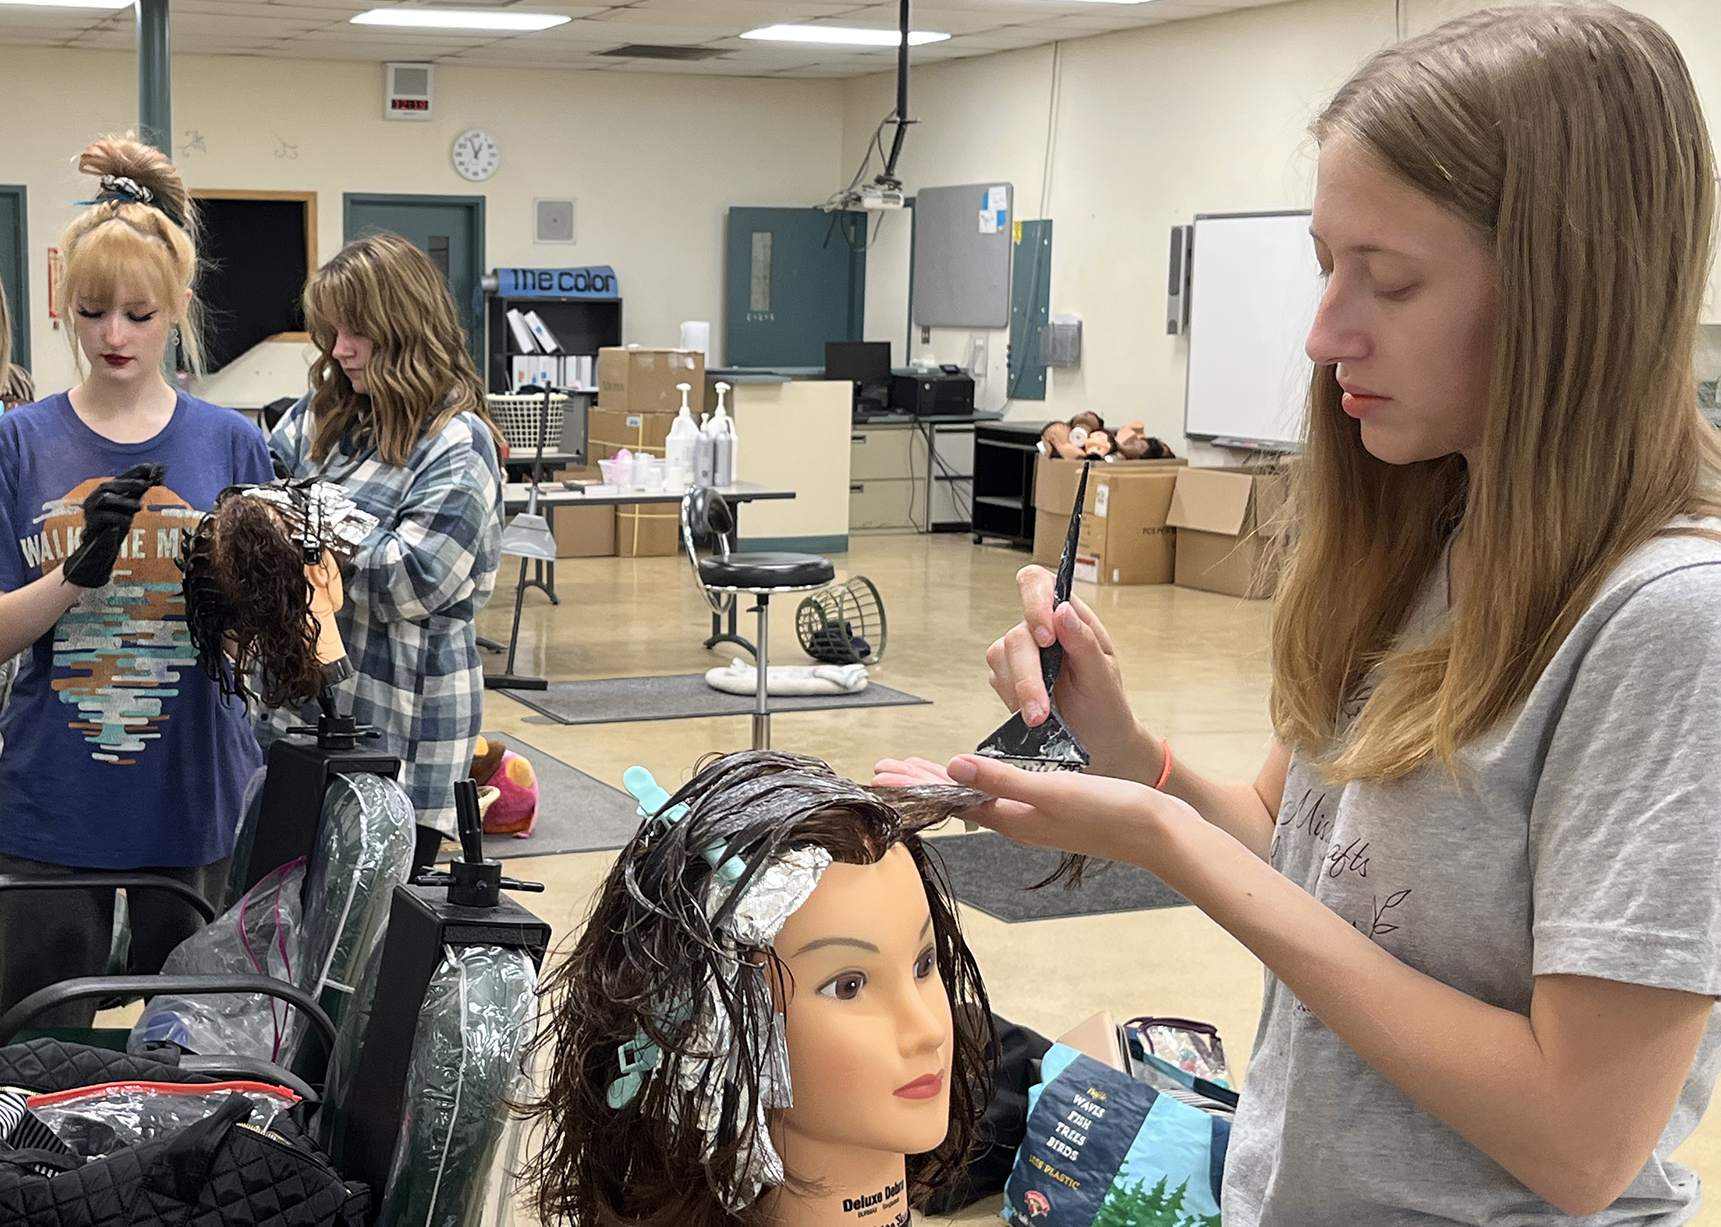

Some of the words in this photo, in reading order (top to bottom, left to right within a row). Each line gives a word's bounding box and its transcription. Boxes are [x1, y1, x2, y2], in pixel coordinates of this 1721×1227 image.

[557, 268, 616, 293] color
[20, 526, 83, 568] WALK
[1072, 1093, 1106, 1119] WAVES
[1055, 1121, 1087, 1147] TREES
[1066, 1110, 1093, 1132] FISH
[1045, 1136, 1079, 1162] BIRDS
[1044, 1164, 1081, 1191] PLASTIC
[842, 1191, 883, 1213] Deluxe
